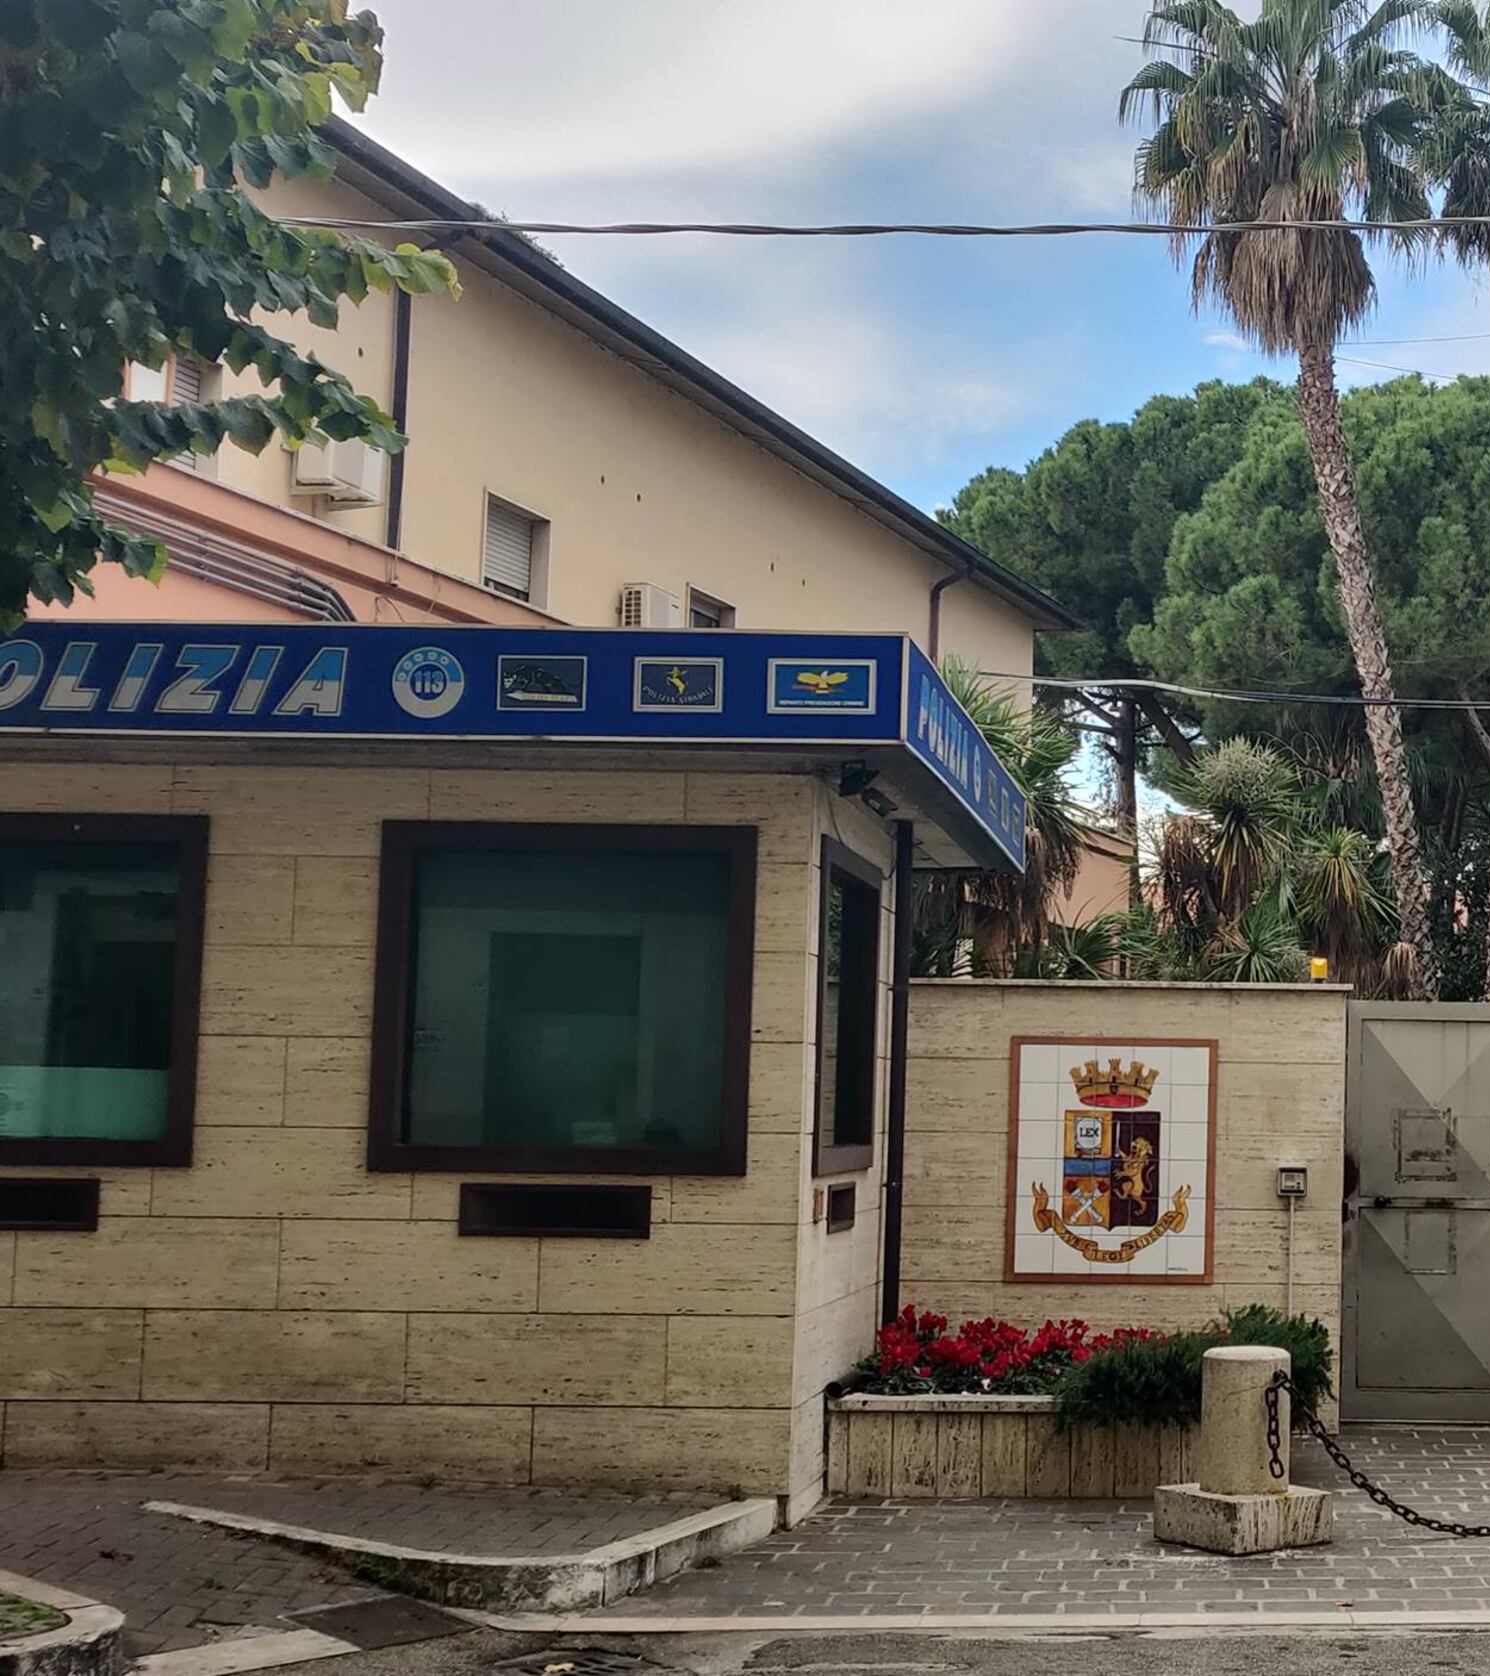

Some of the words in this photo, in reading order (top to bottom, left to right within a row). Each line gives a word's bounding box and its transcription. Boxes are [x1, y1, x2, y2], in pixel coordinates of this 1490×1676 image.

[414, 670, 445, 694] 113
[917, 673, 969, 791] POLIZIA
[1079, 1126, 1100, 1138] LEX
